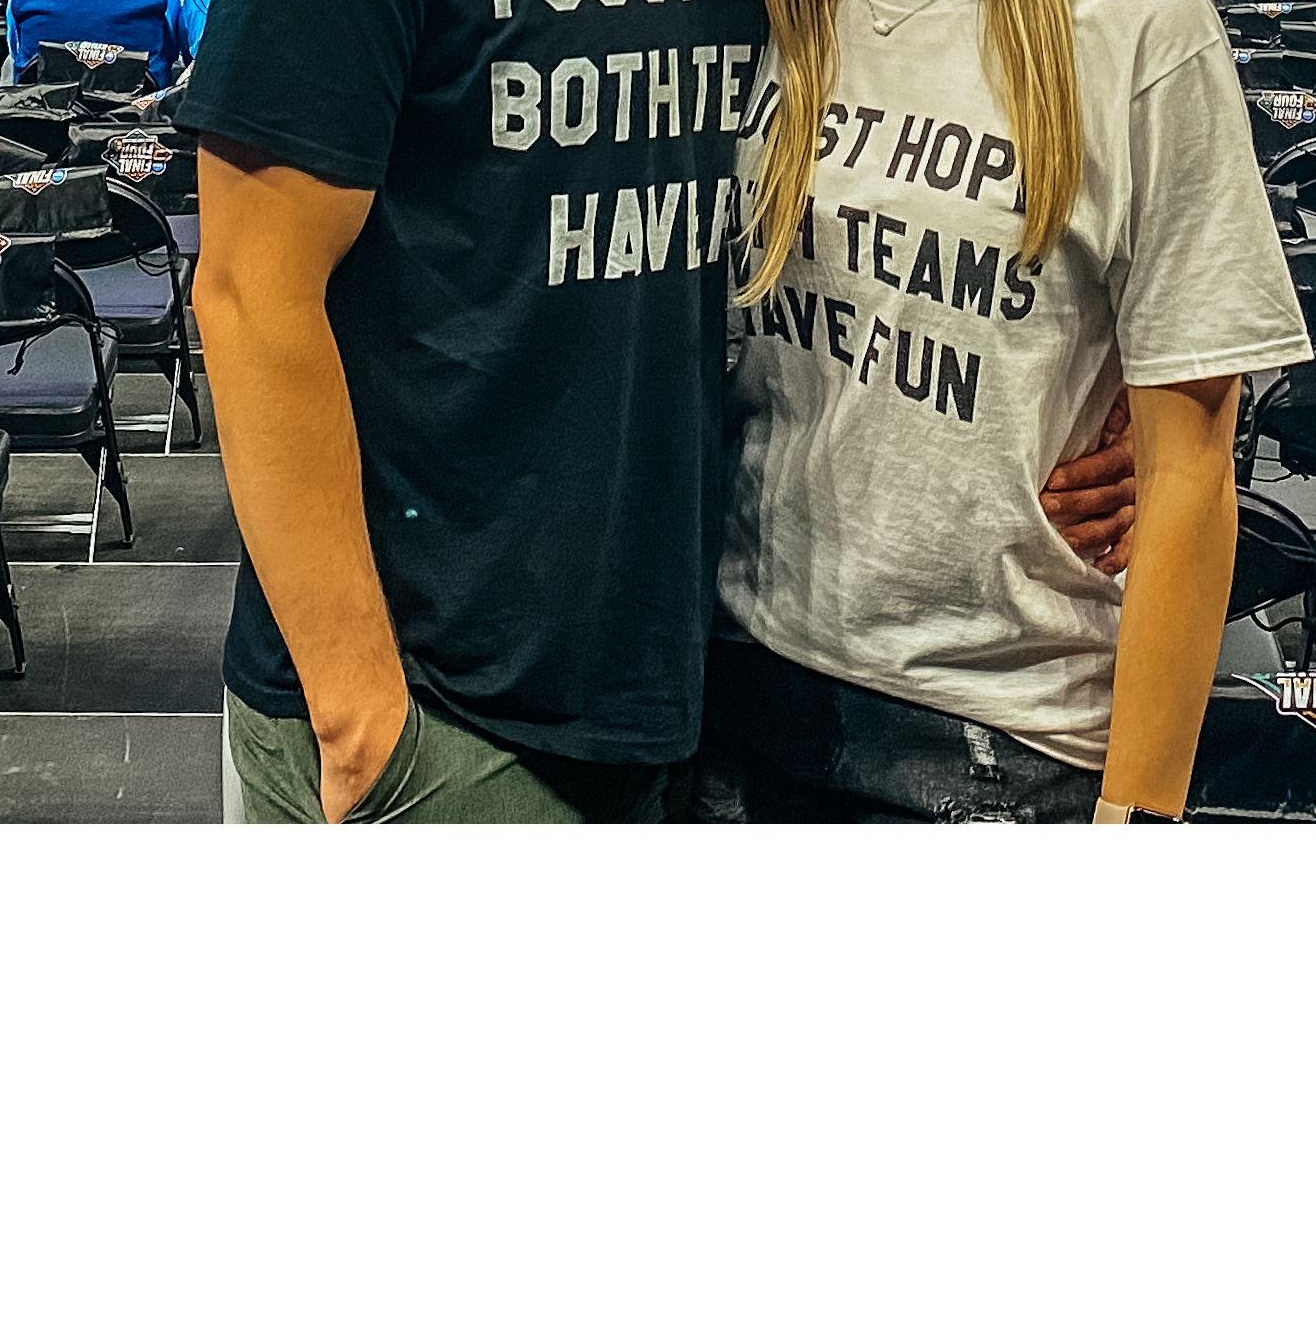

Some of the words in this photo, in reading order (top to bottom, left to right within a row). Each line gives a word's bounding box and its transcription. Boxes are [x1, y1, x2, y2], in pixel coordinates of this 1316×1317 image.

[490, 47, 681, 151] BOTH
[885, 113, 1027, 215] HOP
[836, 204, 1044, 322] TEAMS
[859, 315, 982, 424] FUN
